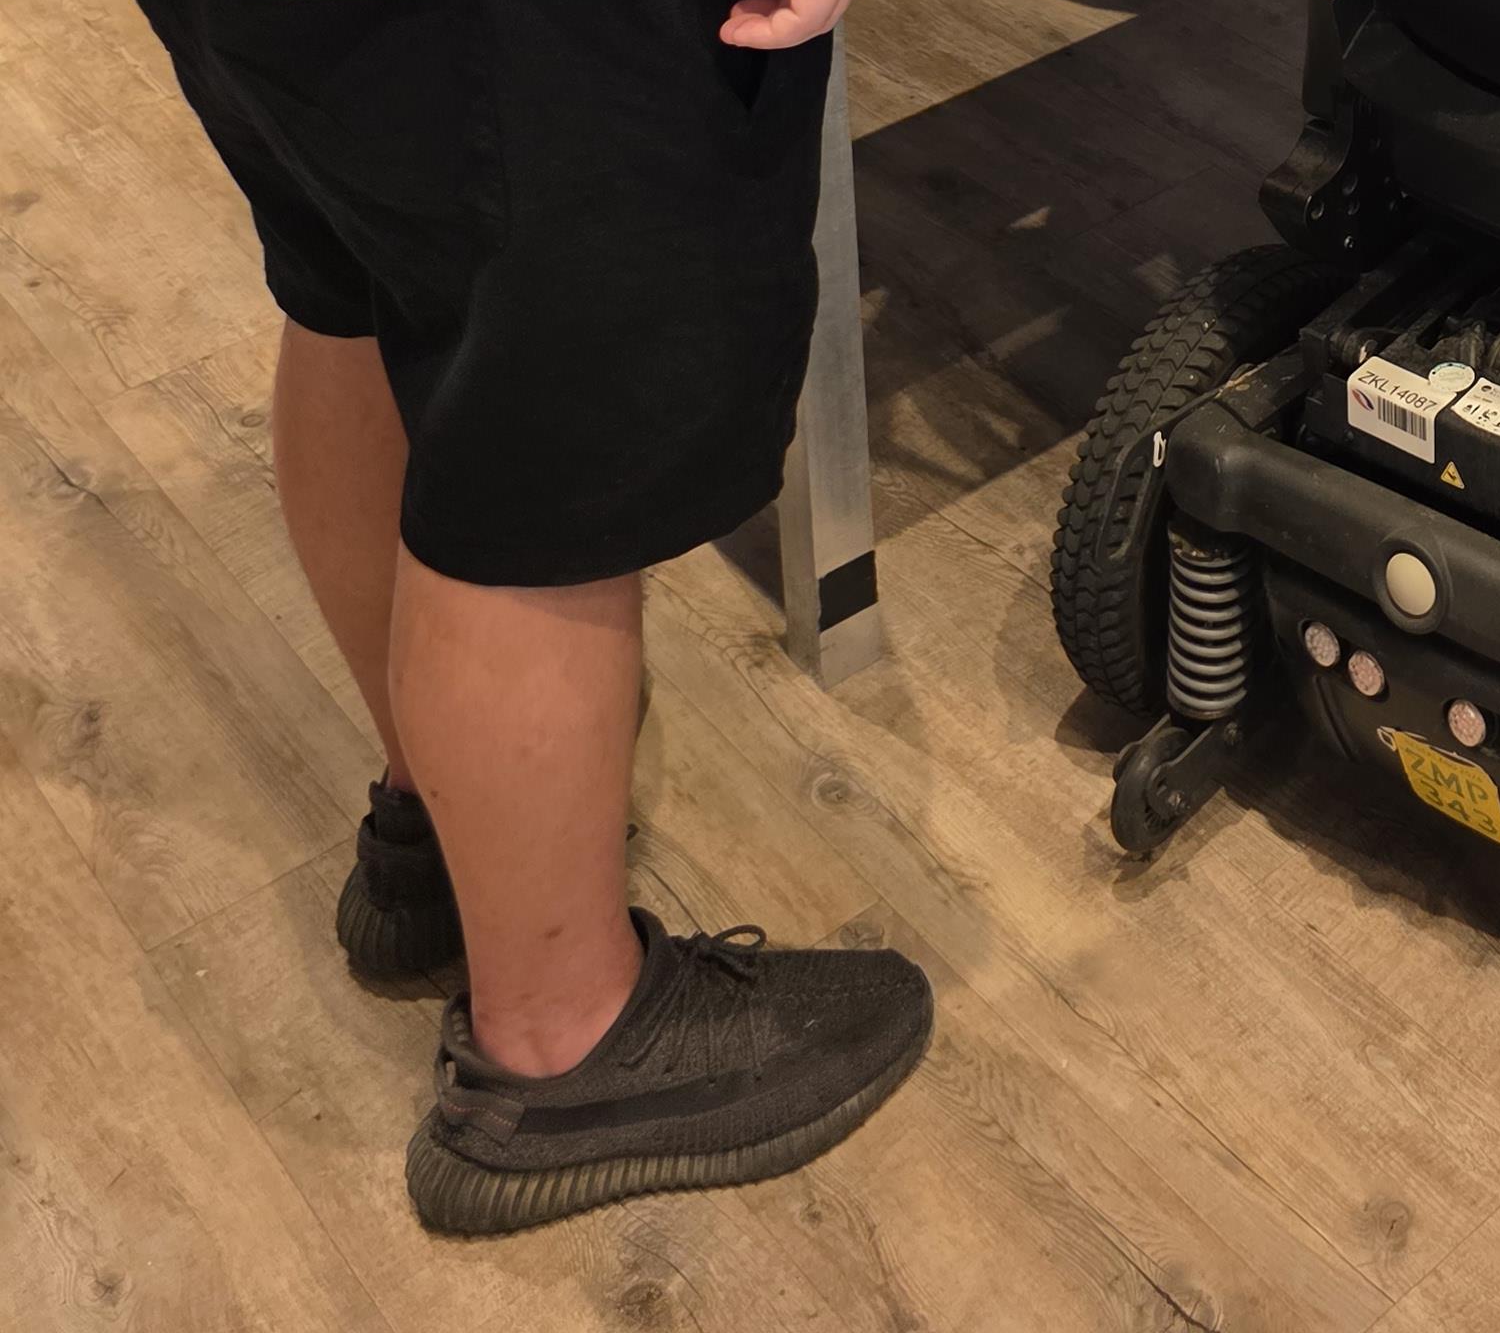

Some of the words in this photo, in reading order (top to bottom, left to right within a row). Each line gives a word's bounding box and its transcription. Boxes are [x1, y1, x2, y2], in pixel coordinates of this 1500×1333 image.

[1357, 370, 1438, 412] ZKL14087
[1404, 747, 1489, 805] ZMP
[1420, 779, 1498, 835] 343
